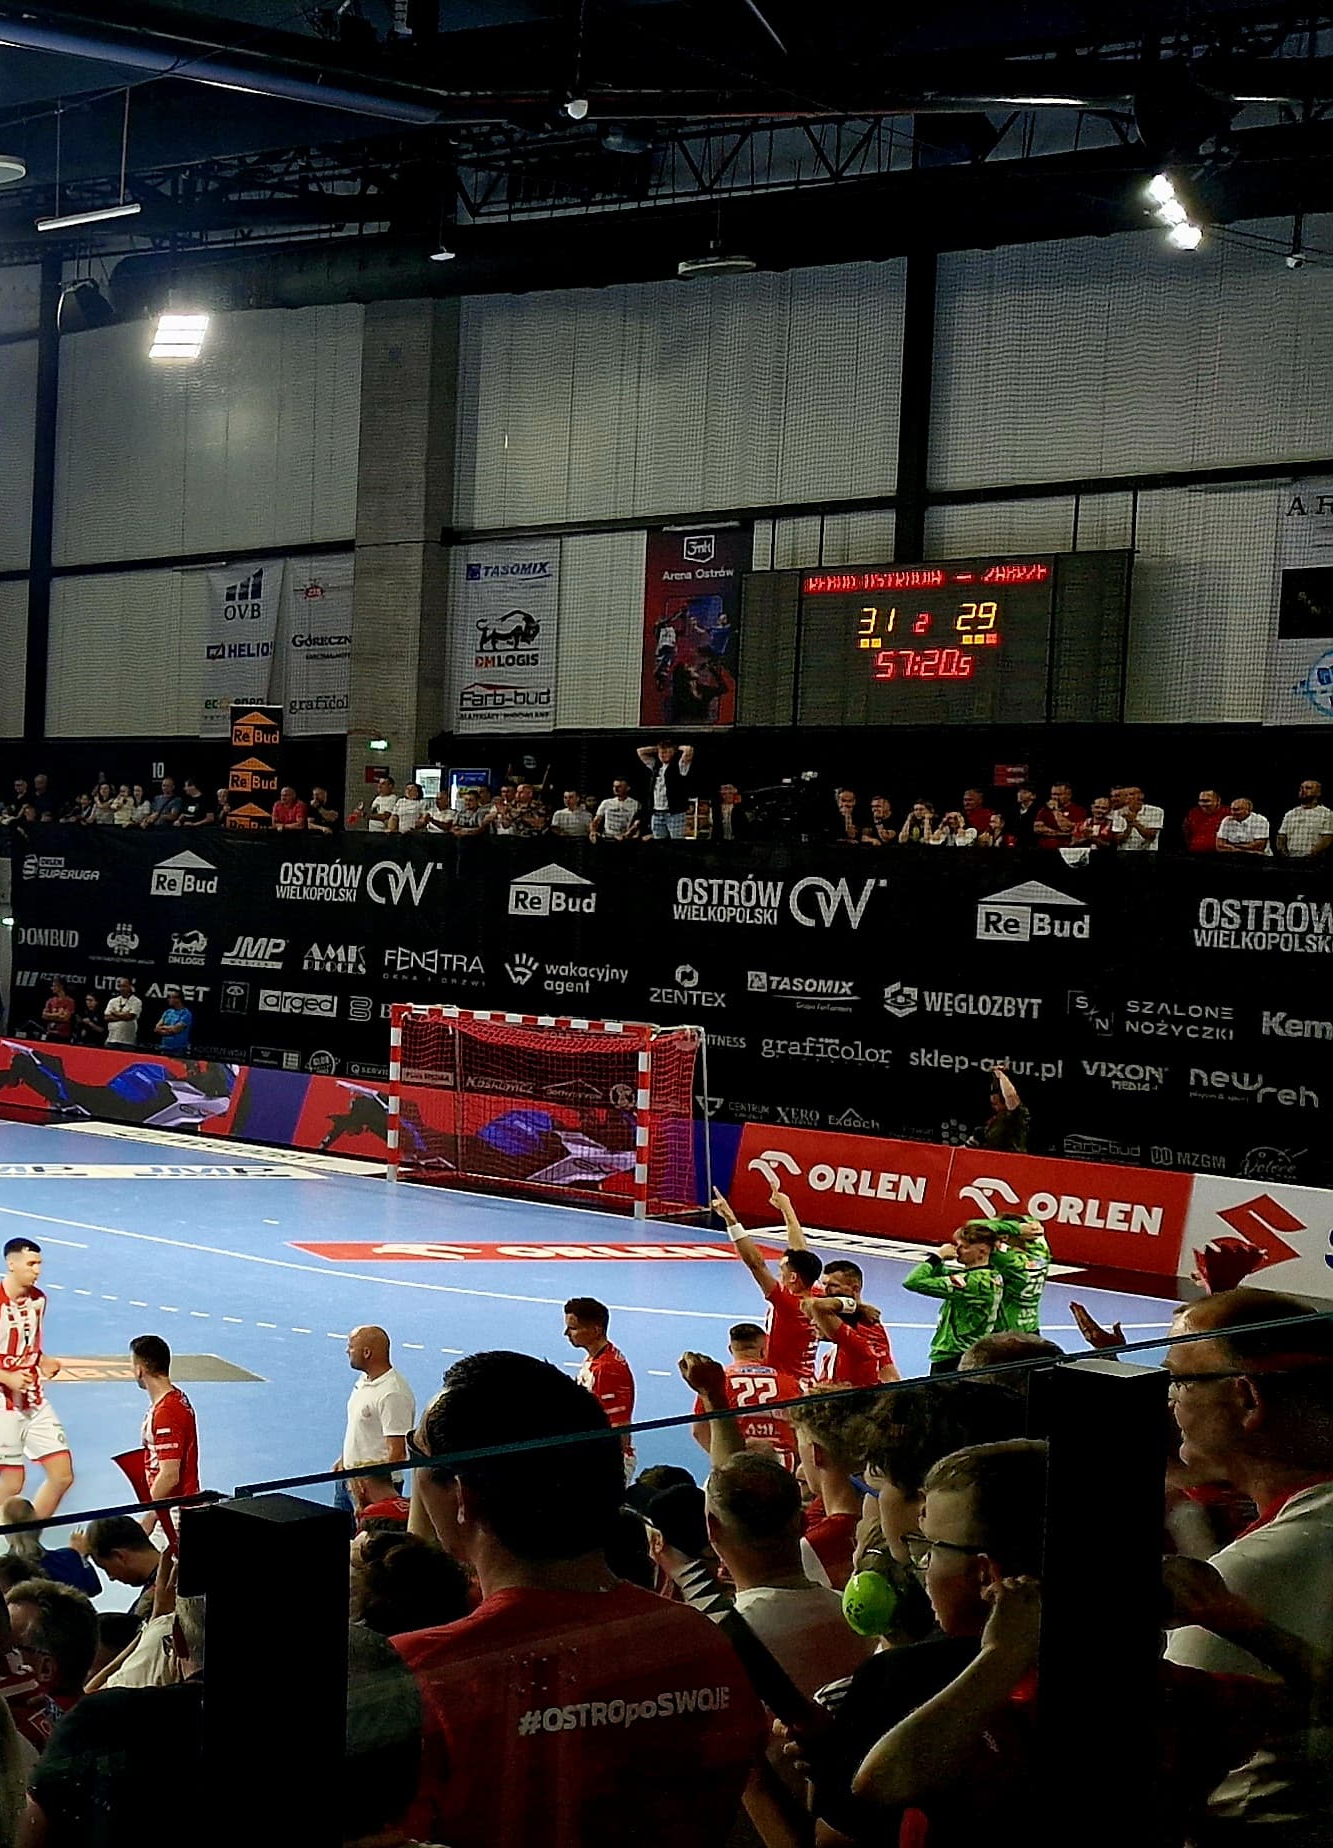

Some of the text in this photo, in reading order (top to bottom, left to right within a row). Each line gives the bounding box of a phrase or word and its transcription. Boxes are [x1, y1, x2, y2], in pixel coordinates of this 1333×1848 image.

[483, 562, 549, 577] TASOMIX
[662, 567, 734, 581] Arena Ostrów
[224, 603, 261, 621] OVB
[858, 607, 896, 634] 31
[956, 602, 998, 630] 29
[475, 653, 539, 669] DMLOGIS
[459, 688, 551, 707] Farb-bud
[151, 762, 165, 779] 10
[279, 858, 363, 888] OSTRÓW
[275, 885, 357, 902] WIELKOPOLSKI
[676, 873, 785, 908] OSTRÓW
[672, 904, 779, 926] WIELKOPOLSKI
[223, 936, 286, 960] JMP
[1192, 928, 1333, 953] WIELKOPOLSK
[544, 962, 629, 985] wakacyjny
[544, 980, 592, 996] agent
[769, 976, 855, 996] TASOMIX
[263, 992, 334, 1014] arged
[648, 988, 727, 1008] ZENTEX
[923, 991, 1043, 1019] WĘGLOZBYT
[1126, 1000, 1234, 1020] SZALONE
[1125, 1020, 1234, 1041] NOŻYCZKI
[761, 1037, 893, 1064] graficolor
[1081, 1059, 1164, 1085] VIXON
[776, 1106, 820, 1124] XERO
[1177, 1151, 1227, 1169] MZGM
[807, 1161, 927, 1205] ORLEN
[1027, 1191, 1164, 1237] ORLEN
[496, 1245, 738, 1259] ORLEN
[730, 1376, 779, 1408] 22
[517, 1686, 732, 1737] #OSTROpoSWOJE
